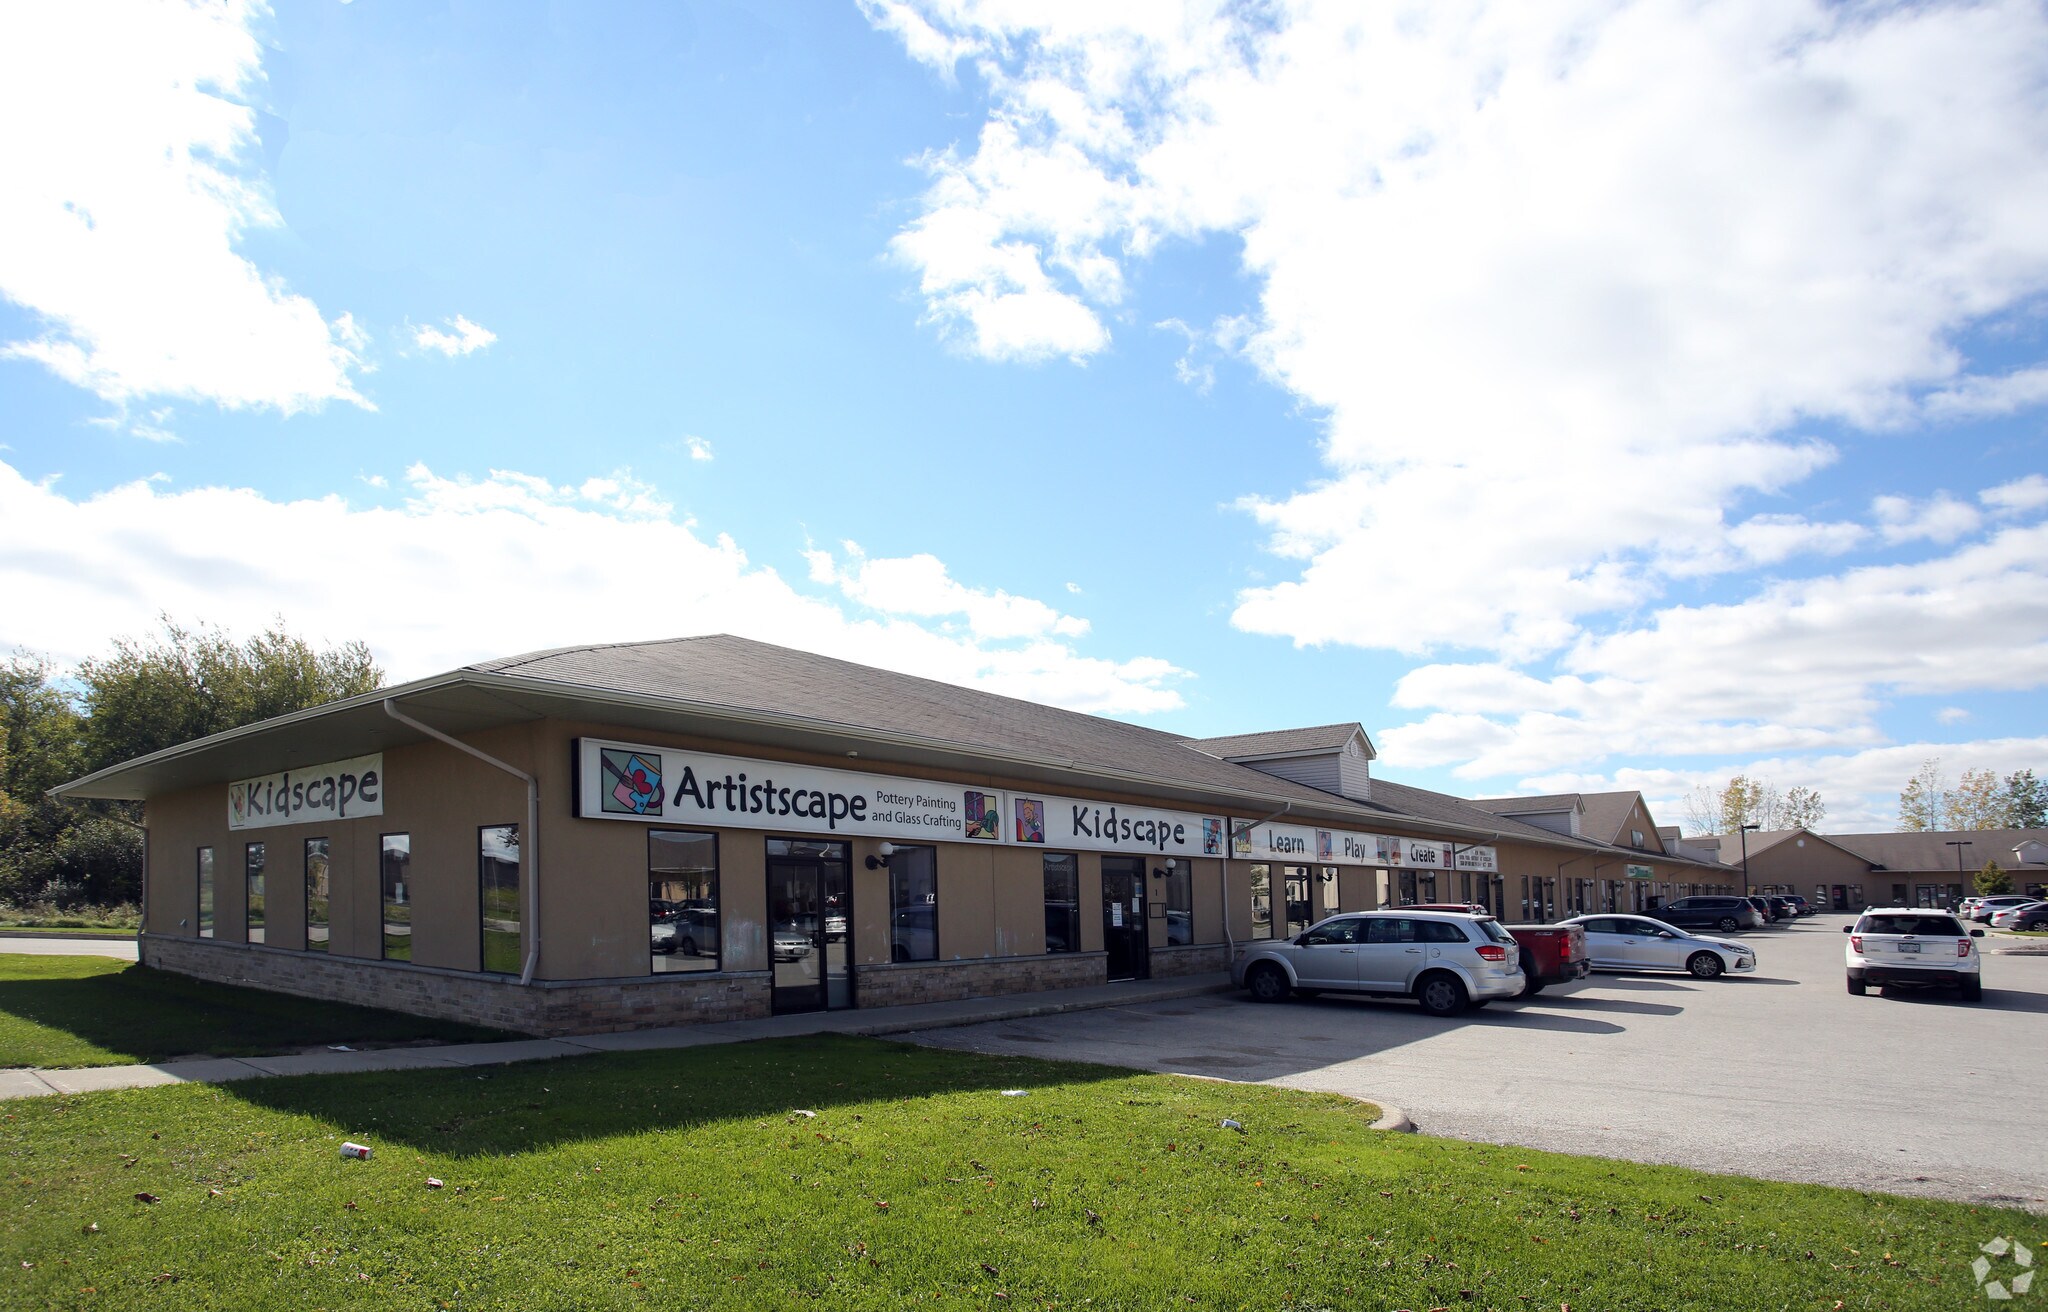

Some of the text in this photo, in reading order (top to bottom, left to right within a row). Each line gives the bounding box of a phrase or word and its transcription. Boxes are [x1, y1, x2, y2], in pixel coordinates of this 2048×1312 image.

[247, 770, 378, 817] Kidscape
[673, 766, 867, 829] Artistscape
[876, 790, 956, 812] Pottery Painting
[871, 810, 962, 831] and Glass Crafting
[1072, 805, 1185, 851] Kidscape
[1269, 829, 1304, 854] Learn
[1344, 837, 1366, 863] Play
[1410, 844, 1435, 863] Create
